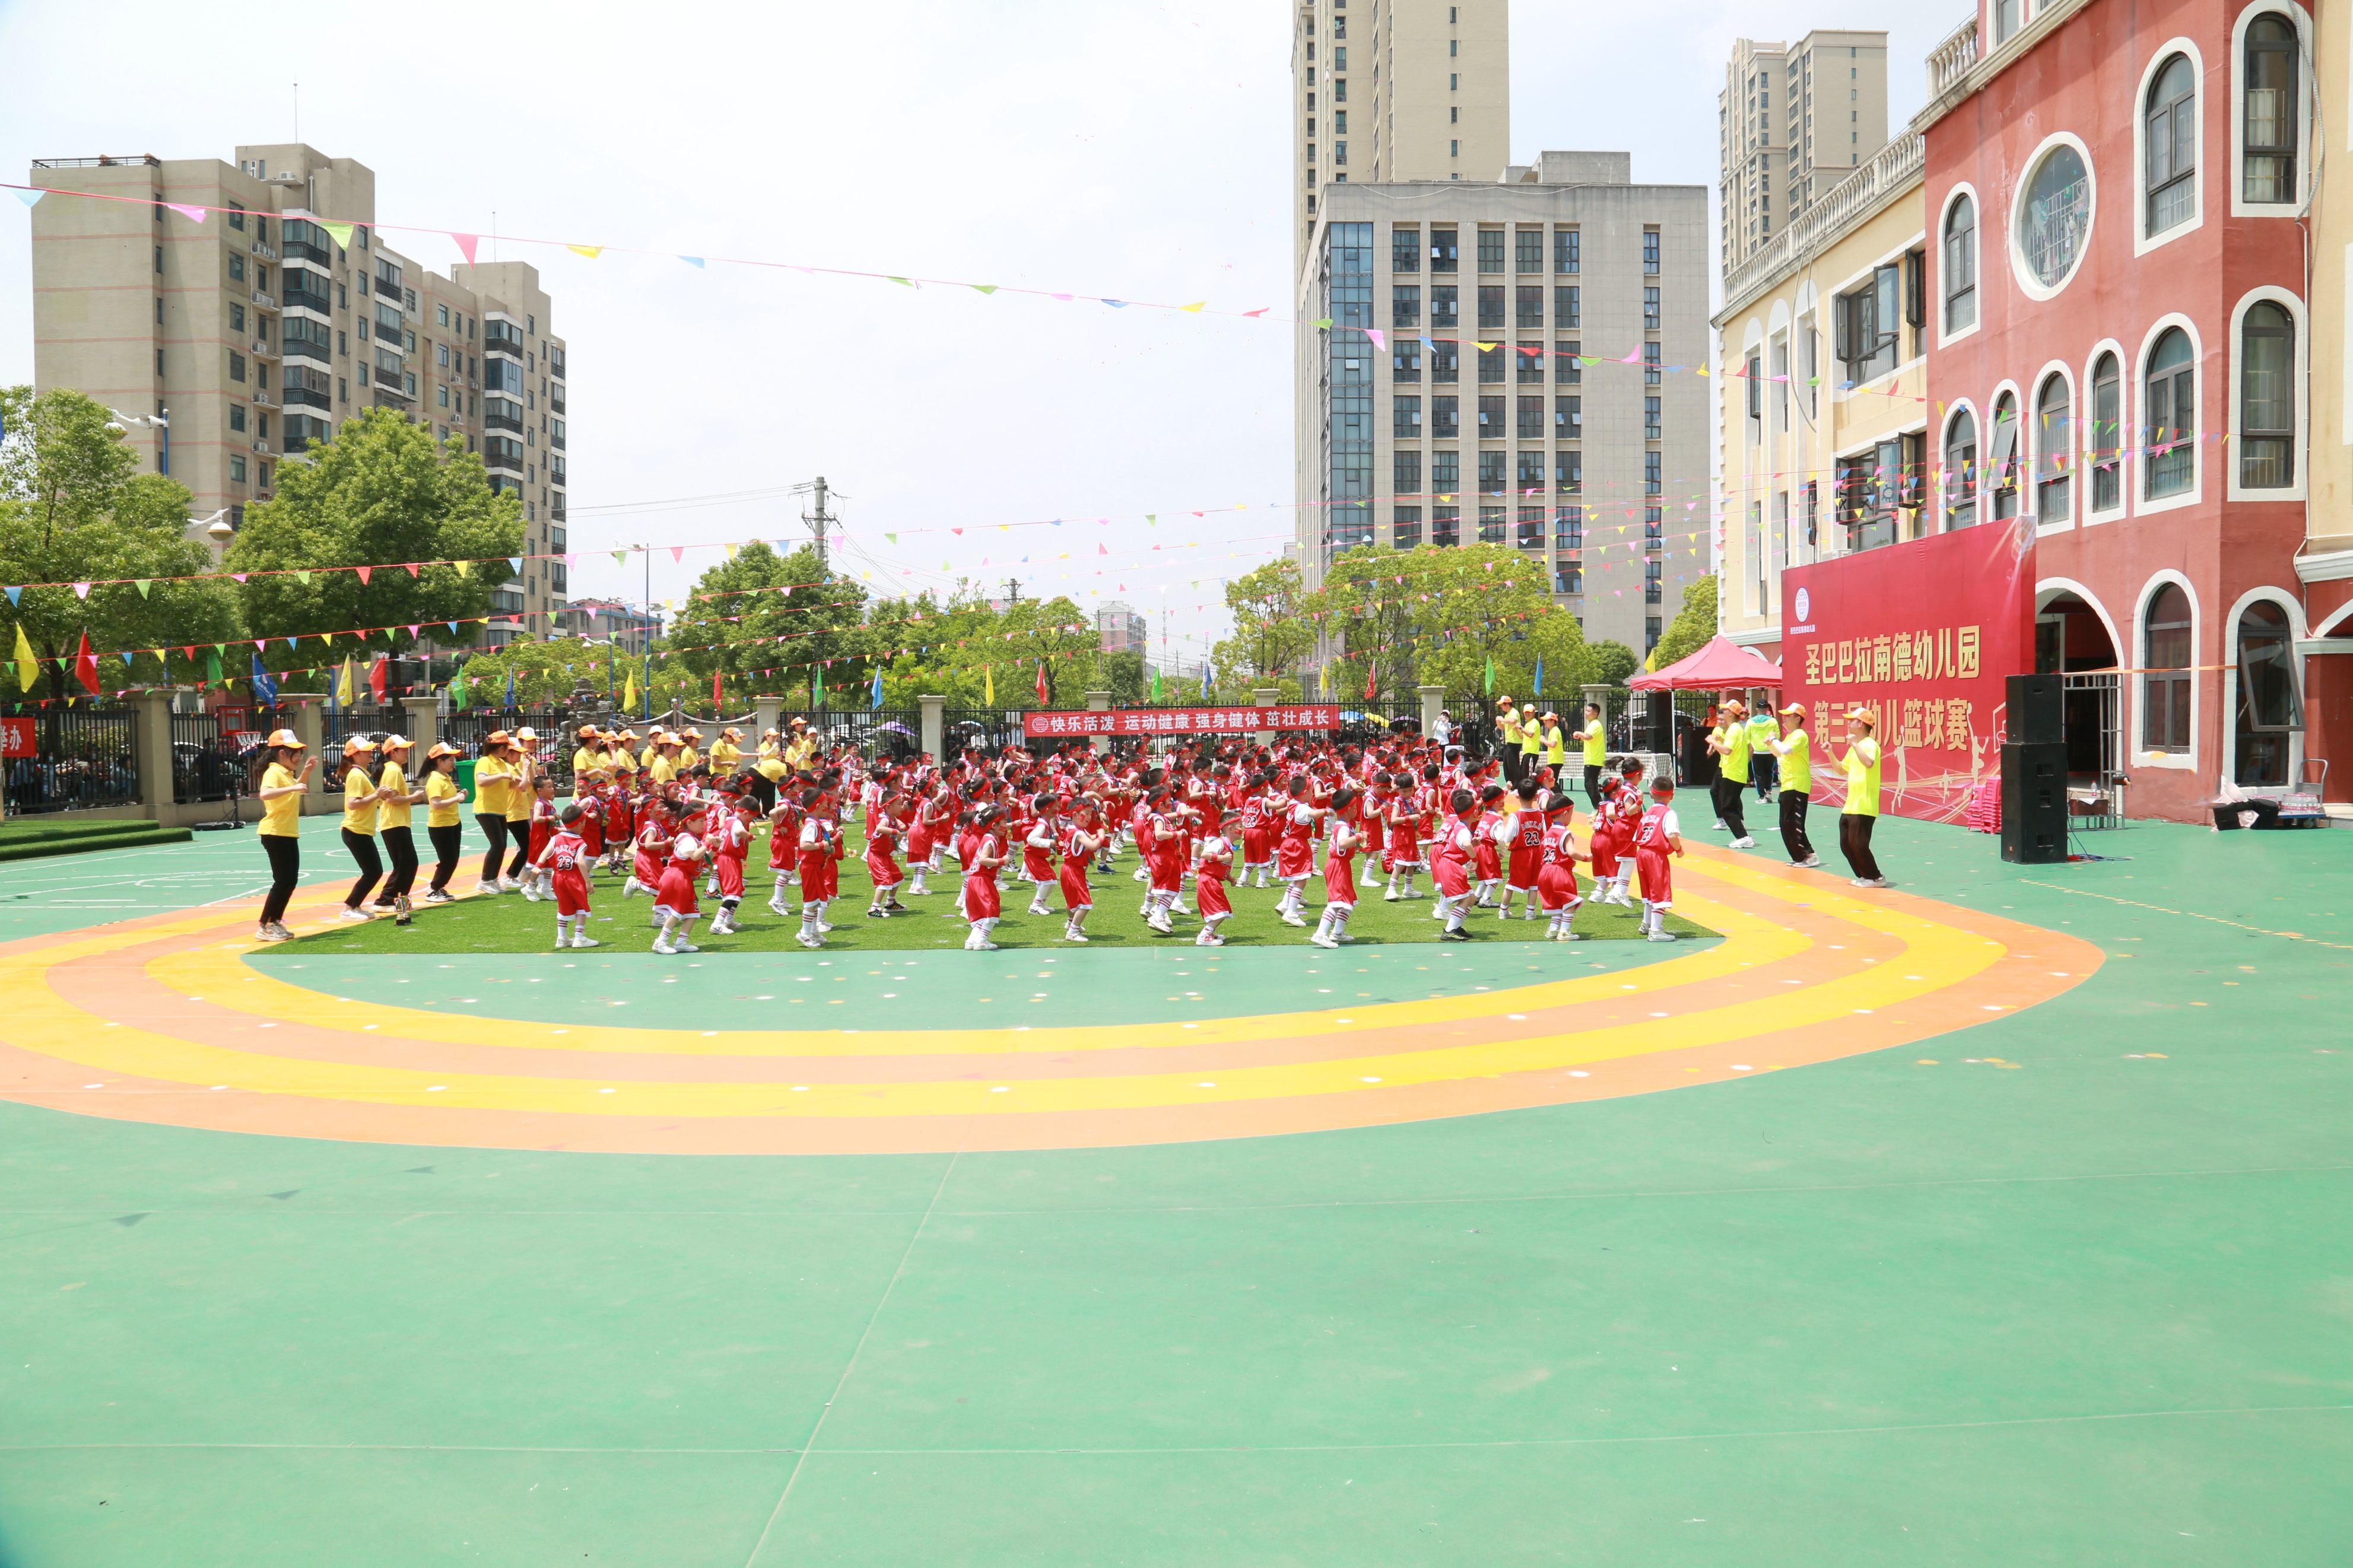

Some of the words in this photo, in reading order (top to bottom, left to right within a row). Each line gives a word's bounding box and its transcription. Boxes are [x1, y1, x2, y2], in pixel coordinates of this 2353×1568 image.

[1805, 625, 1980, 685] 圣巴巴拉南德幼儿园
[1050, 715, 1115, 733] 快乐活泼
[1125, 713, 1190, 731] 运动健康
[1195, 711, 1260, 729] 强身健体
[1265, 710, 1330, 727] 茁壮成长
[1244, 815, 1257, 828] 23
[1524, 831, 1540, 847] 23
[557, 855, 574, 871] 23
[1543, 848, 1555, 864] 23
